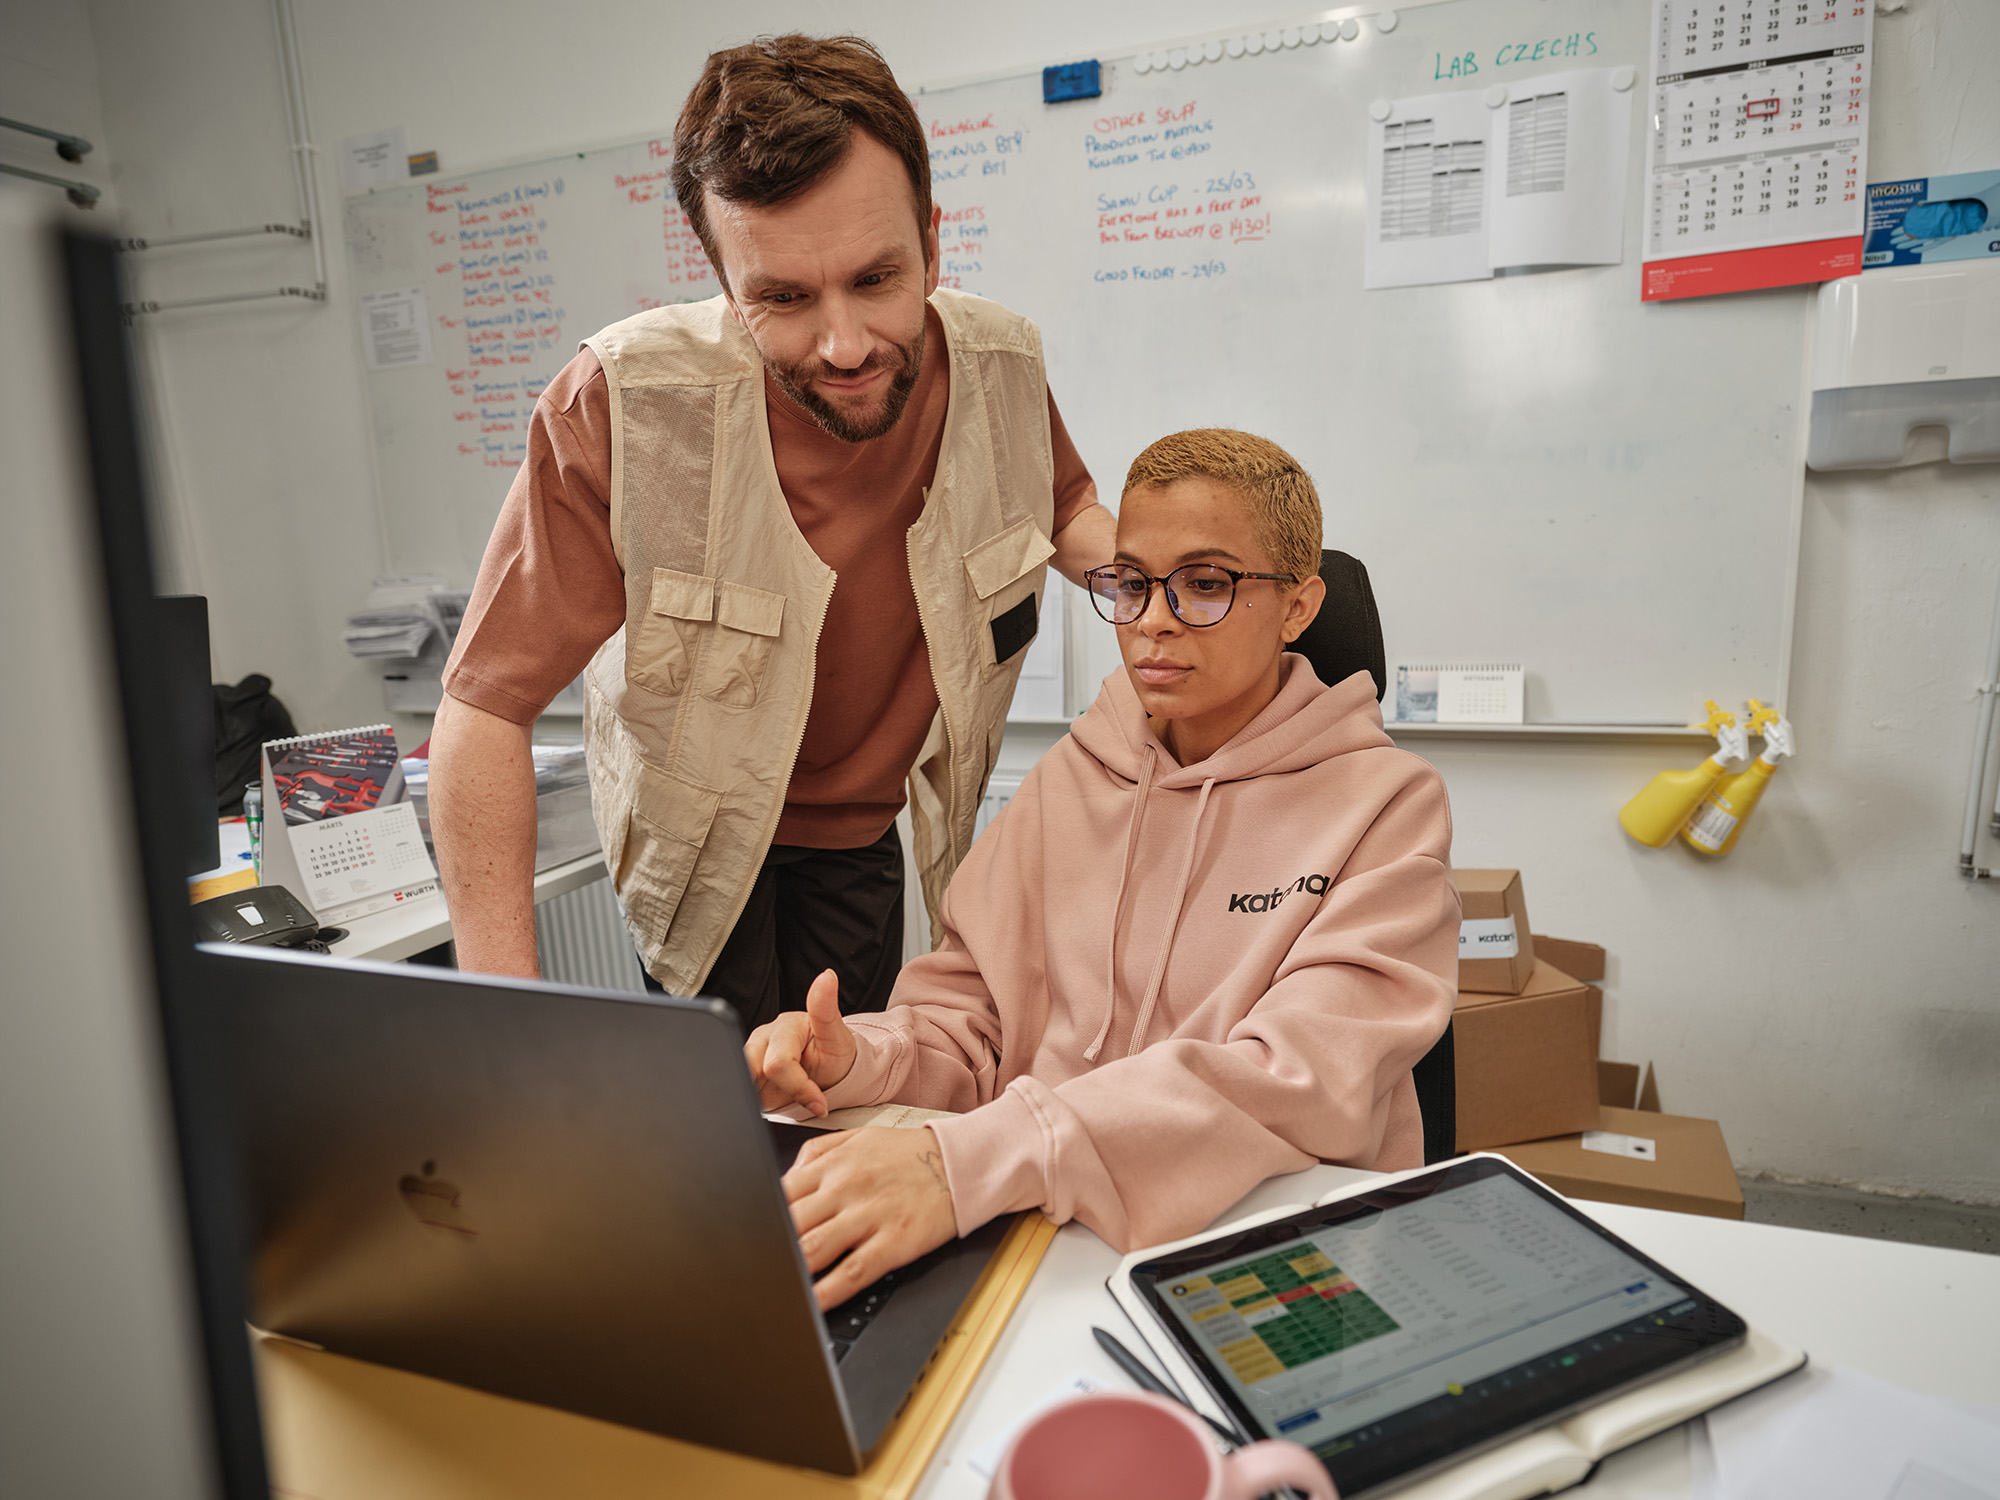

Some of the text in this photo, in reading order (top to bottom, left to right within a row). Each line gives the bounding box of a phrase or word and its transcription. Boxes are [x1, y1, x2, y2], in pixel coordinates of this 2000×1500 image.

[1688, 22, 1697, 30] 12
[1713, 30, 1724, 38] 20
[1768, 21, 1778, 29] 22
[1824, 12, 1835, 20] 24
[1853, 8, 1864, 16] 25
[1712, 42, 1723, 51] 27
[1740, 38, 1750, 46] 28
[1767, 34, 1778, 42] 29
[1434, 32, 1598, 80] LAB CZECHS
[1833, 46, 1864, 56] MARCH
[1827, 67, 1833, 75] 2
[1741, 93, 1748, 101] 6
[1737, 106, 1747, 114] 13
[1765, 101, 1775, 109] 14
[1093, 100, 1197, 133] OTHER STUFF
[1736, 118, 1747, 126] 20
[1763, 114, 1774, 122] 21
[1792, 110, 1802, 118] 22
[1820, 106, 1830, 114] 23
[1085, 133, 1158, 153] PRODUCTION
[1682, 139, 1691, 147] 25
[1735, 131, 1745, 139] 27
[1791, 123, 1801, 131] 29
[1148, 185, 1178, 204] CUP
[1206, 171, 1256, 194] 25/03
[1816, 184, 1827, 192] 20
[1195, 205, 1203, 215] A
[1240, 195, 1262, 210] DAY
[1705, 211, 1715, 219] 23
[1760, 204, 1770, 212] 25
[1816, 197, 1826, 205] 27
[1844, 193, 1855, 201] 28
[1209, 223, 1223, 239] @
[1678, 227, 1688, 235] 29
[1864, 253, 1886, 263] Nitril
[1094, 268, 1128, 282] GOOD
[1133, 266, 1176, 281] FRIDAY
